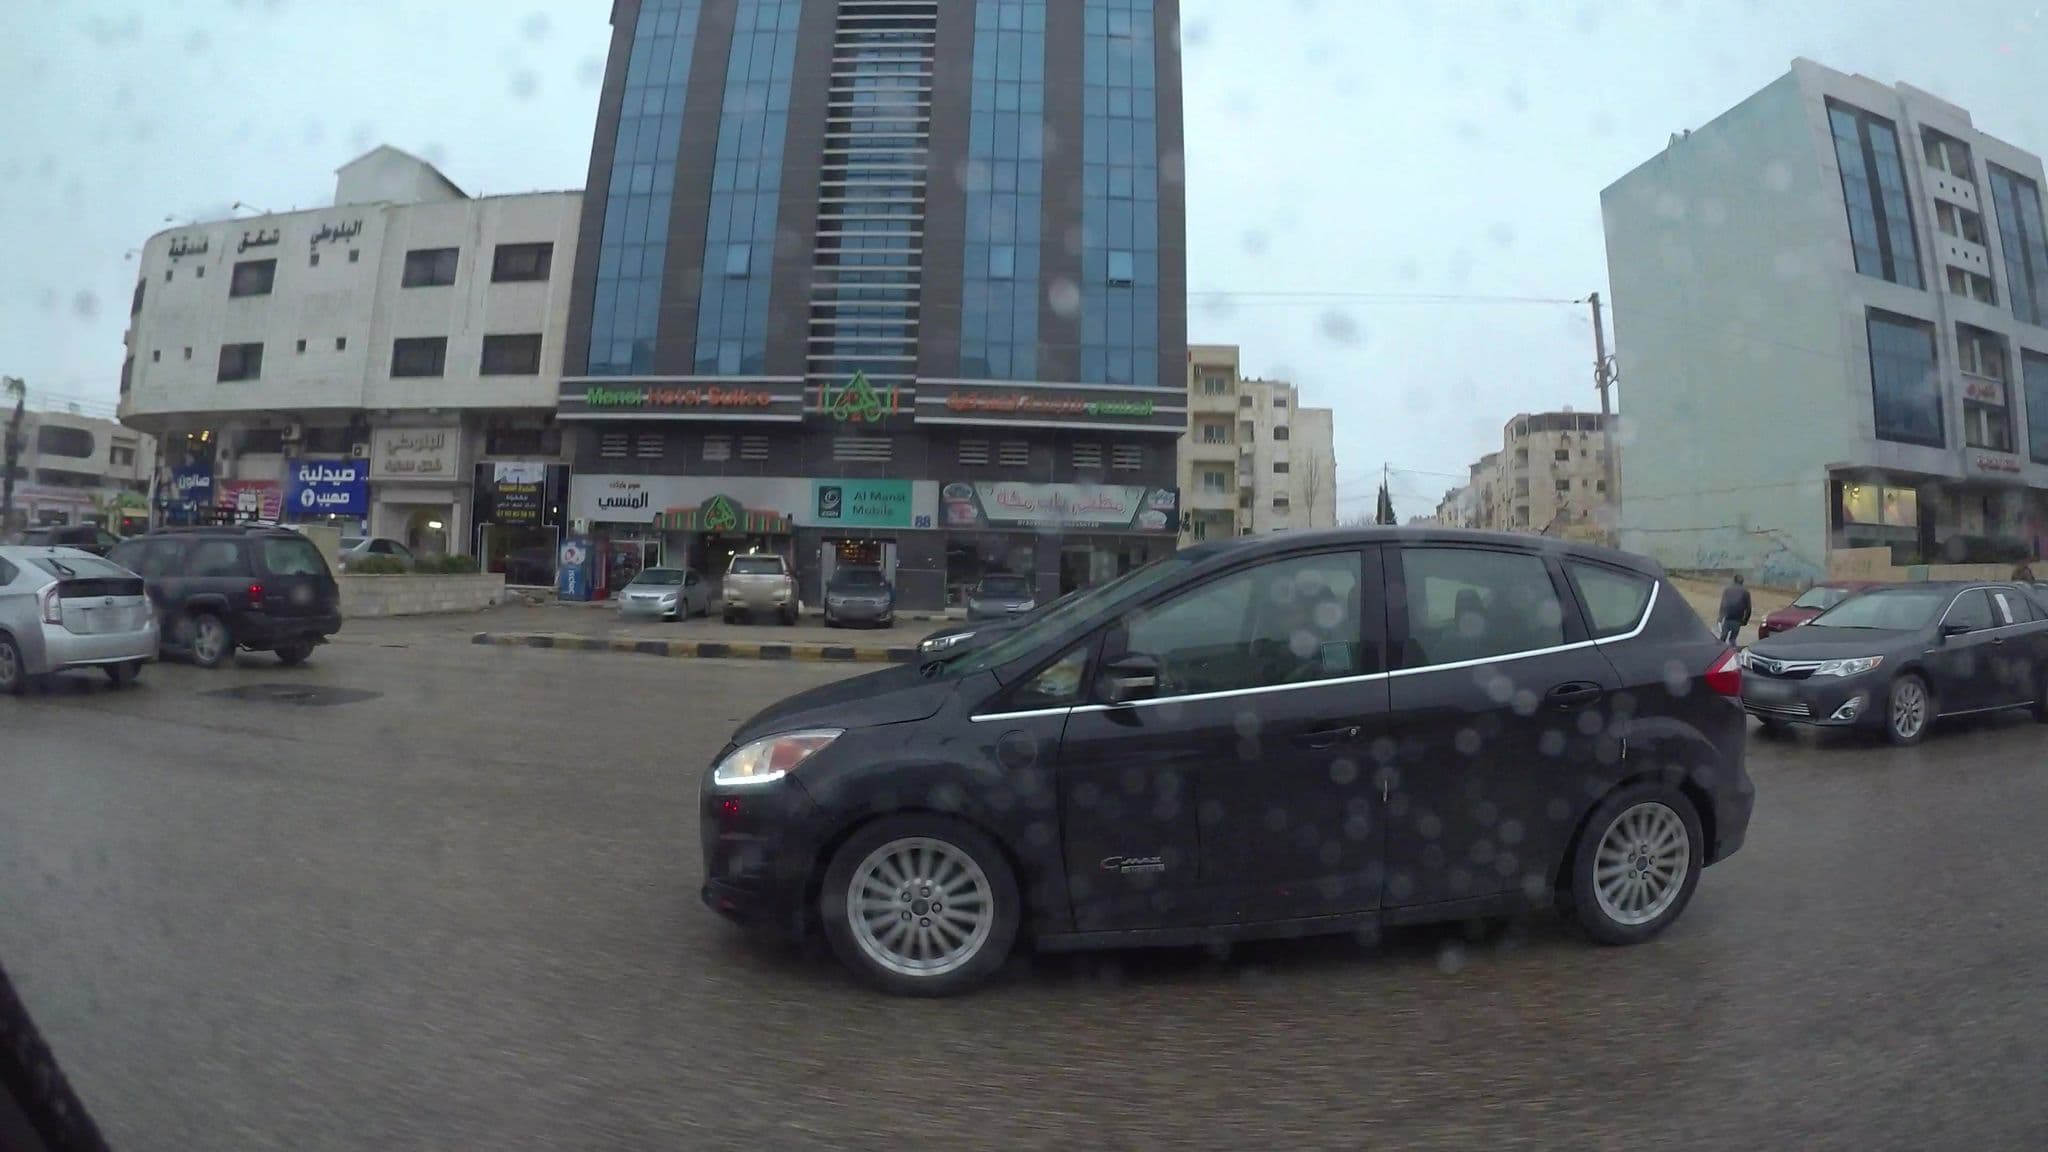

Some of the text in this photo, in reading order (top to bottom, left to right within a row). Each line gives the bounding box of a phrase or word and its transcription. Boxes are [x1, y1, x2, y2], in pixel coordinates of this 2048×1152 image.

[178, 475, 211, 489] صالون
[299, 464, 356, 486] صيدلية
[598, 491, 649, 511] المنسي
[914, 514, 932, 529] 88
